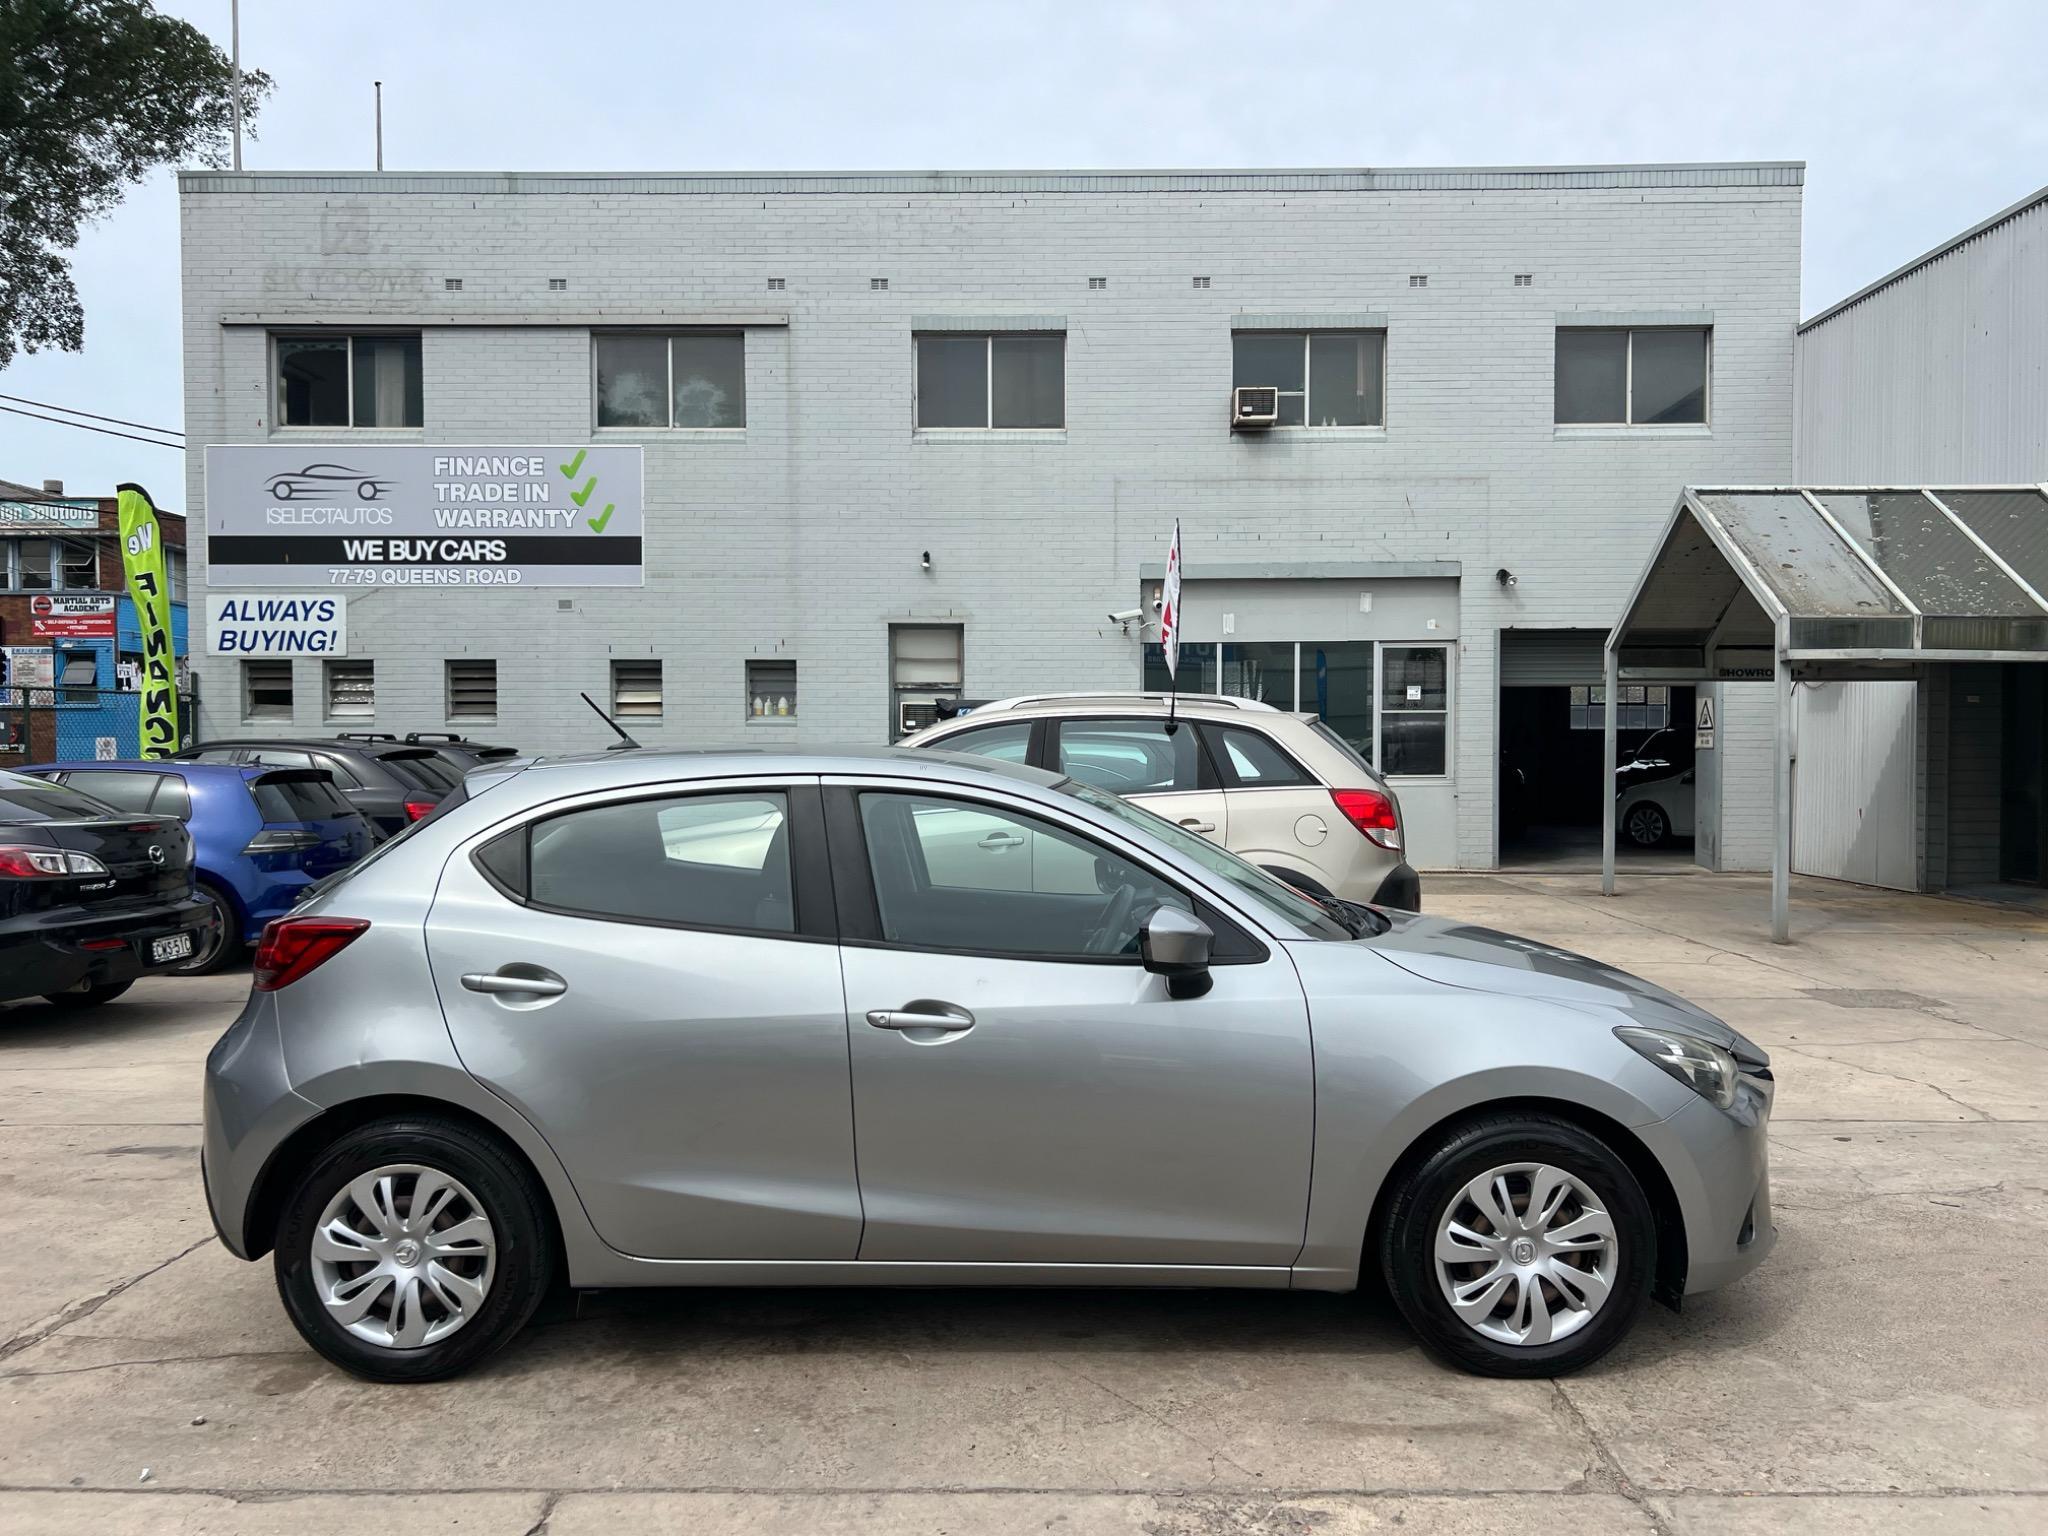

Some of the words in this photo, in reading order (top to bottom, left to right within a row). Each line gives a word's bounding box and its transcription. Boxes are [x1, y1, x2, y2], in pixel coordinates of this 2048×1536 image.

[433, 456, 545, 477] FINANCE
[433, 483, 519, 502] TRADE
[523, 483, 550, 502] IN
[29, 503, 95, 520] Solutions
[266, 508, 393, 525] ISELECTAUTOS
[433, 509, 579, 528] WARRANTY
[343, 540, 384, 561] WE
[388, 540, 439, 561] BUY
[439, 540, 507, 561] CARS
[328, 569, 377, 585] 77-79
[382, 569, 461, 585] QUEENS
[465, 569, 522, 585] ROAD
[53, 597, 88, 605] MARTIAL
[89, 597, 111, 605] ARTS
[218, 600, 336, 623] ALWAYS
[217, 629, 338, 653] BUYING!
